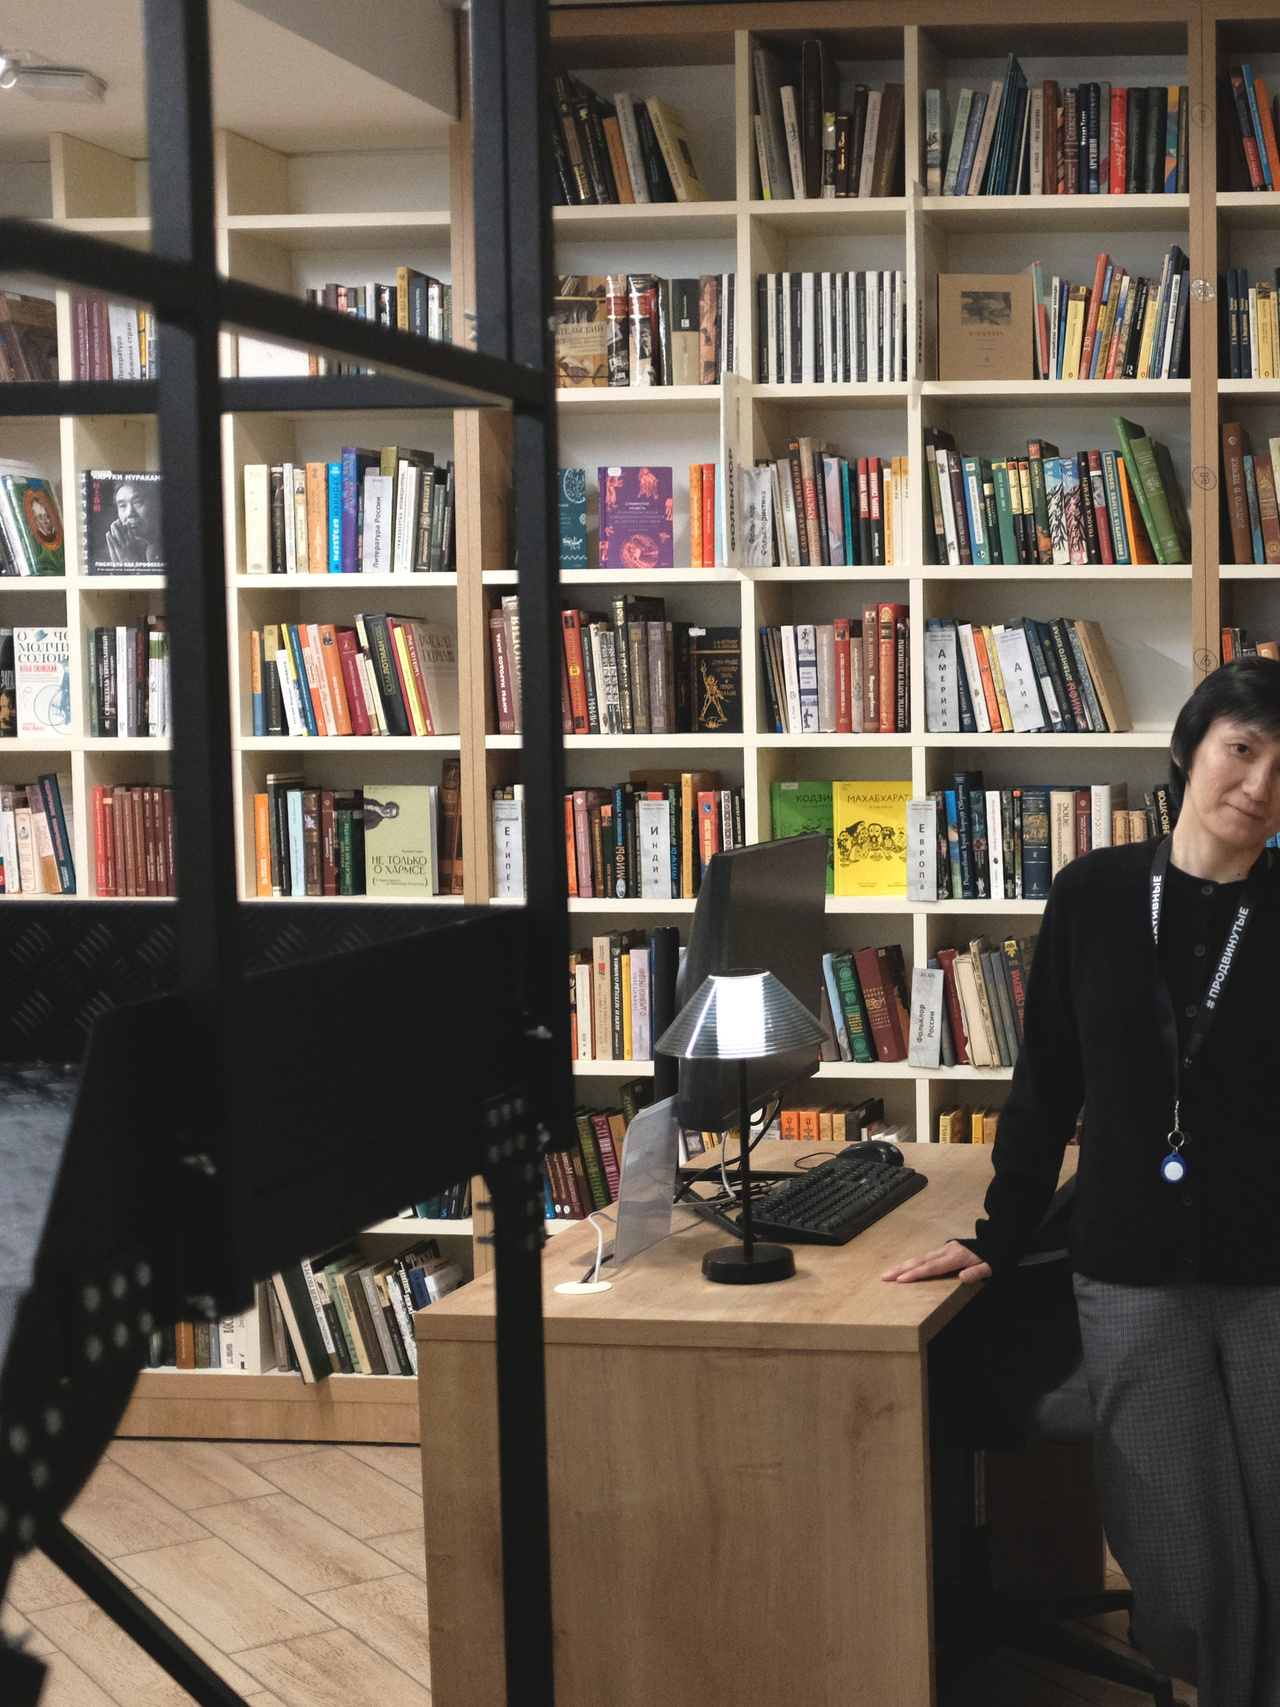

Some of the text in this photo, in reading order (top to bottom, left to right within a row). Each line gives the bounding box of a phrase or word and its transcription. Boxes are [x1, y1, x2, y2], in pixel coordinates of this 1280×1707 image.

[1088, 138, 1098, 170] АРСЕНИЙ
[727, 447, 737, 552] ФОЛЬКЛОР
[792, 460, 808, 553] СЛОВАРЬ СИМВОЛОВ
[804, 478, 816, 520] КРЫЛАТЫЕ
[331, 474, 340, 563] ХРОНИКИ БРЭДБЕРИ
[372, 495, 382, 569] Литература России
[748, 502, 757, 544] Фольклор.
[759, 491, 768, 556] Фольклористика
[1085, 509, 1094, 537] ГОЛОСА
[377, 640, 392, 675] ЛОТМАН
[586, 697, 597, 726] МИФЫ
[1067, 681, 1082, 715] МИФЫ
[371, 855, 428, 866] НЕ ТОЛЬКО
[373, 865, 426, 876] О ХАРМСЕ
[616, 846, 625, 879] МИФЫ
[1208, 905, 1250, 999] ПРОДВИНУТЫЕ
[916, 1003, 926, 1044] Фольклор
[927, 1010, 936, 1038] России
